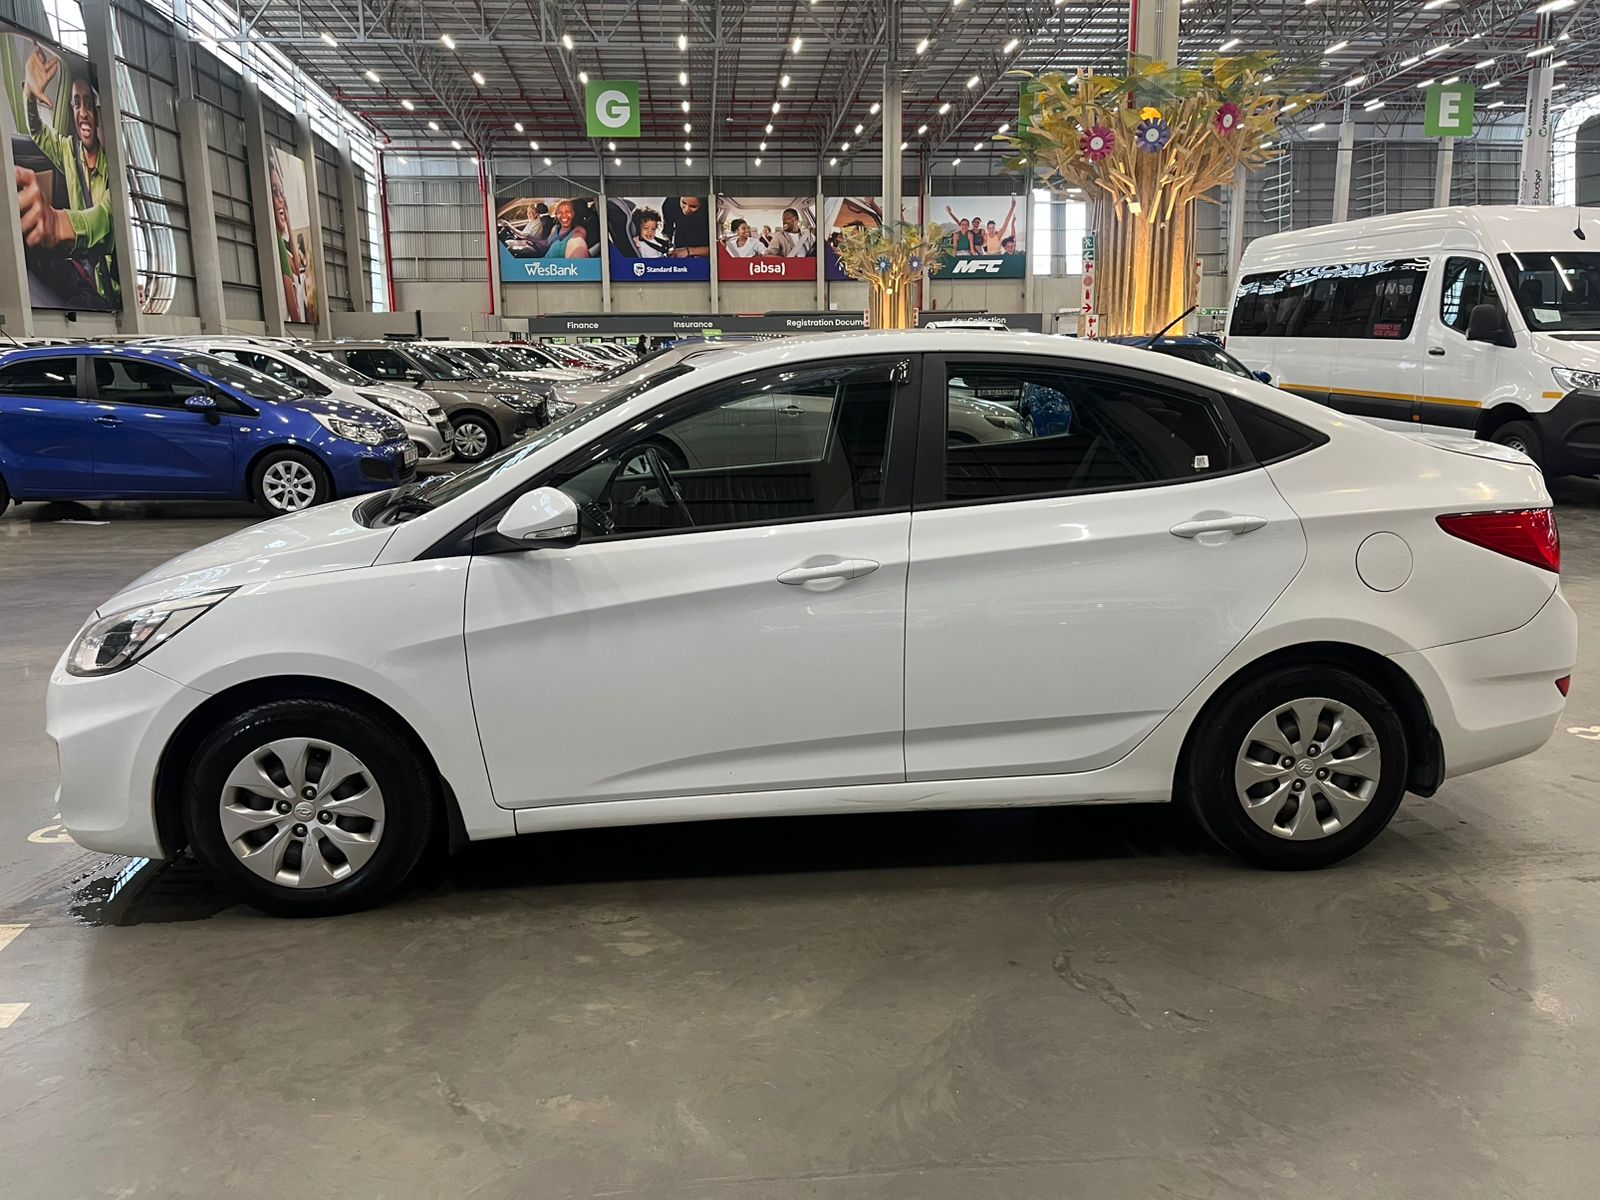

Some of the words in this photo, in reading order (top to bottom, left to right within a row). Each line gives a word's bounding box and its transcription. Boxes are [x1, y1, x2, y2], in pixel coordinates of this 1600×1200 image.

[595, 90, 630, 128] G
[1439, 92, 1461, 127] E
[525, 262, 578, 276] WesBank
[952, 259, 1004, 274] MFC
[567, 321, 599, 329] Finance
[786, 319, 833, 328] Registration
